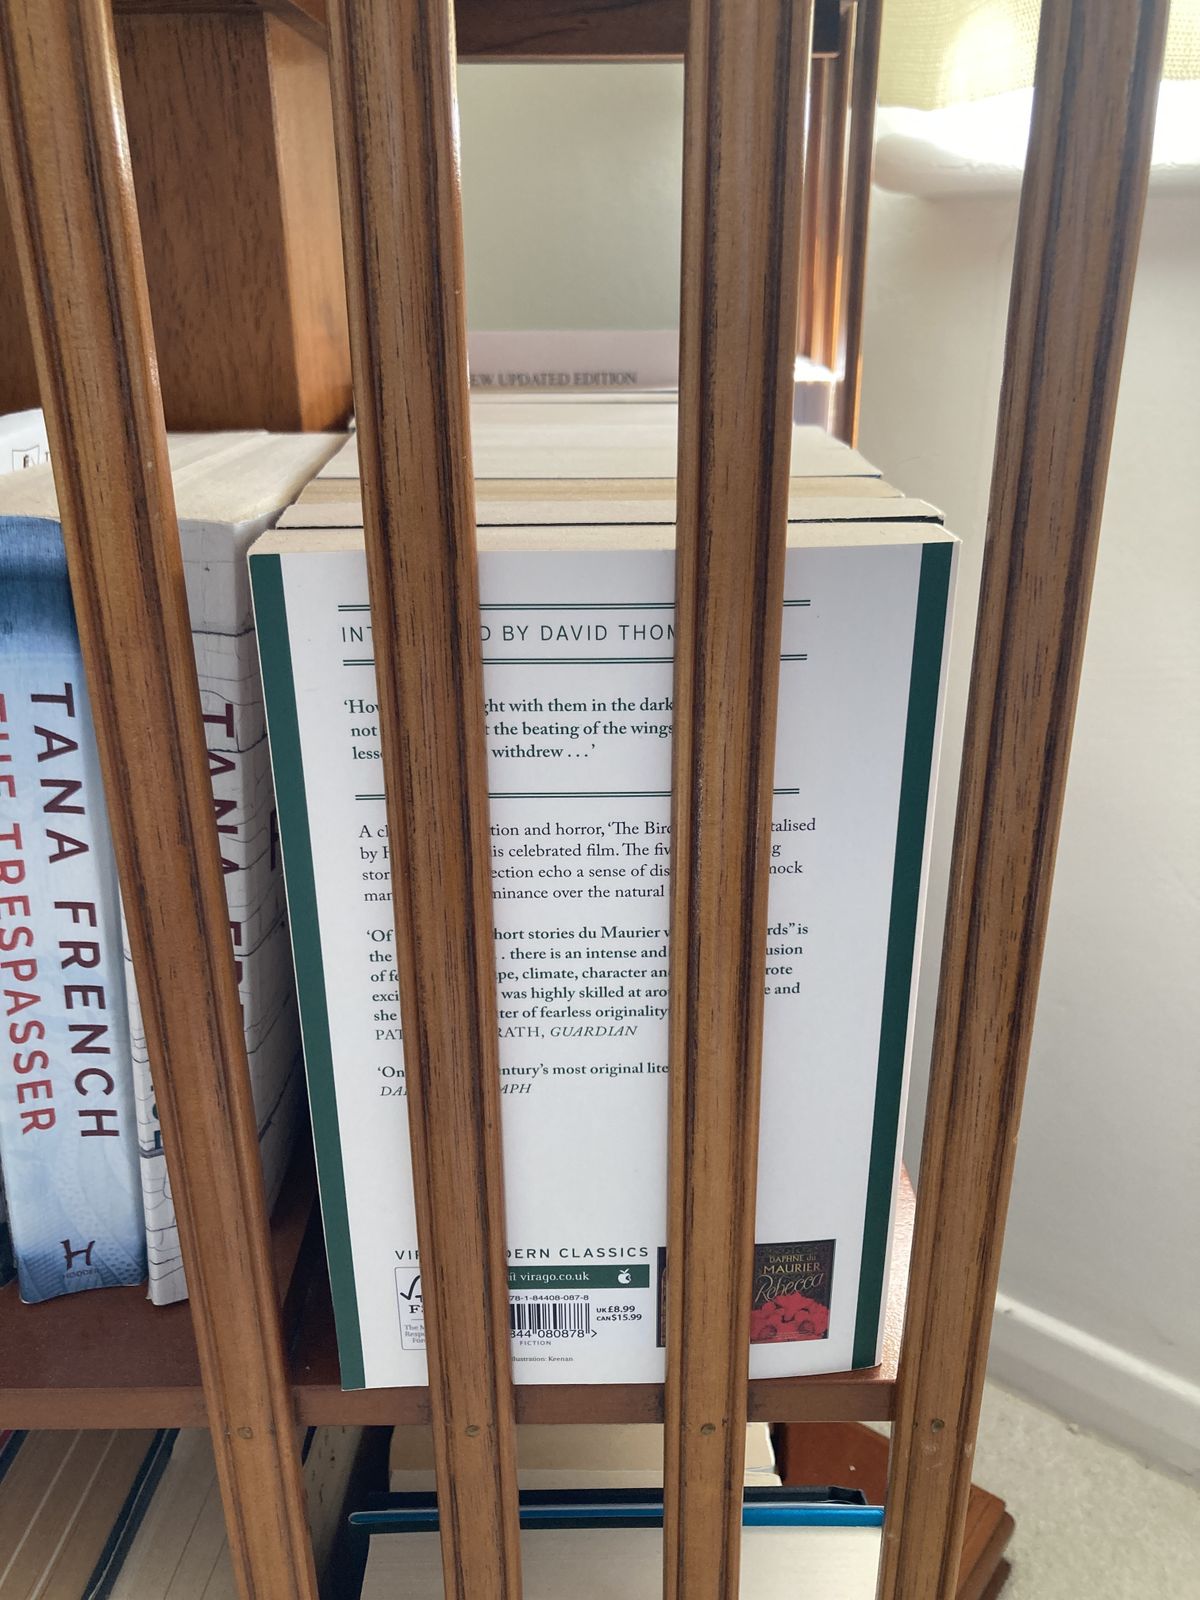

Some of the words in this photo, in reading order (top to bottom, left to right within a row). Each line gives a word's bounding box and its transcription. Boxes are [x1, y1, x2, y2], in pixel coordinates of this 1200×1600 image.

[470, 373, 494, 387] EW
[498, 372, 570, 386] UPDATED
[573, 371, 637, 385] EDITION
[502, 625, 529, 641] BY
[541, 624, 608, 641] DAVID
[618, 624, 675, 641] THOM
[509, 698, 544, 712] with
[548, 698, 588, 712] them
[591, 698, 607, 712] in
[611, 697, 636, 711] the
[350, 725, 377, 737] not
[493, 722, 519, 736] the
[522, 721, 580, 739] beating
[583, 720, 601, 735] of
[603, 721, 627, 735] the
[491, 744, 564, 758] withdrew
[31, 682, 90, 864] TANA
[358, 824, 373, 838] A
[524, 822, 551, 836] and
[556, 822, 605, 838] horror,
[607, 821, 640, 835] ‘The
[770, 817, 816, 832] talised
[360, 846, 378, 864] by
[508, 843, 582, 857] celebrated
[586, 843, 620, 857] film.
[622, 842, 650, 856] The
[538, 865, 572, 879] echo
[576, 868, 585, 878] a
[588, 867, 627, 878] sense
[630, 863, 648, 877] of
[552, 888, 584, 899] over
[588, 885, 611, 899] the
[614, 884, 665, 898] natural
[366, 929, 394, 943] ‘Of
[528, 926, 575, 940] stories
[578, 926, 597, 940] du
[600, 925, 661, 939] Maurier
[797, 923, 809, 935] is
[369, 950, 393, 963] the
[510, 947, 547, 961] there
[550, 947, 562, 960] is
[565, 950, 582, 960] an
[586, 946, 637, 960] intense
[641, 945, 667, 959] and
[370, 969, 387, 983] of
[522, 967, 579, 981] climate,
[582, 966, 648, 980] character
[501, 989, 528, 999] was
[531, 986, 576, 1002] highly
[578, 985, 624, 999] skilled
[628, 987, 642, 998] at
[774, 981, 801, 995] and
[53, 901, 119, 1137] FRENCH
[374, 1009, 398, 1022] she
[522, 1005, 538, 1019] of
[540, 1005, 592, 1019] fearless
[595, 1003, 669, 1020] originality
[550, 1025, 639, 1038] GUARDIAN
[552, 1064, 586, 1076] most
[590, 1061, 644, 1078] original
[559, 1246, 649, 1259] CLASSICS
[769, 1253, 806, 1263] DAPHNE
[763, 1262, 821, 1275] MAURIER
[519, 1271, 590, 1284] virago.co.uk
[754, 1272, 825, 1302] Rebecca
